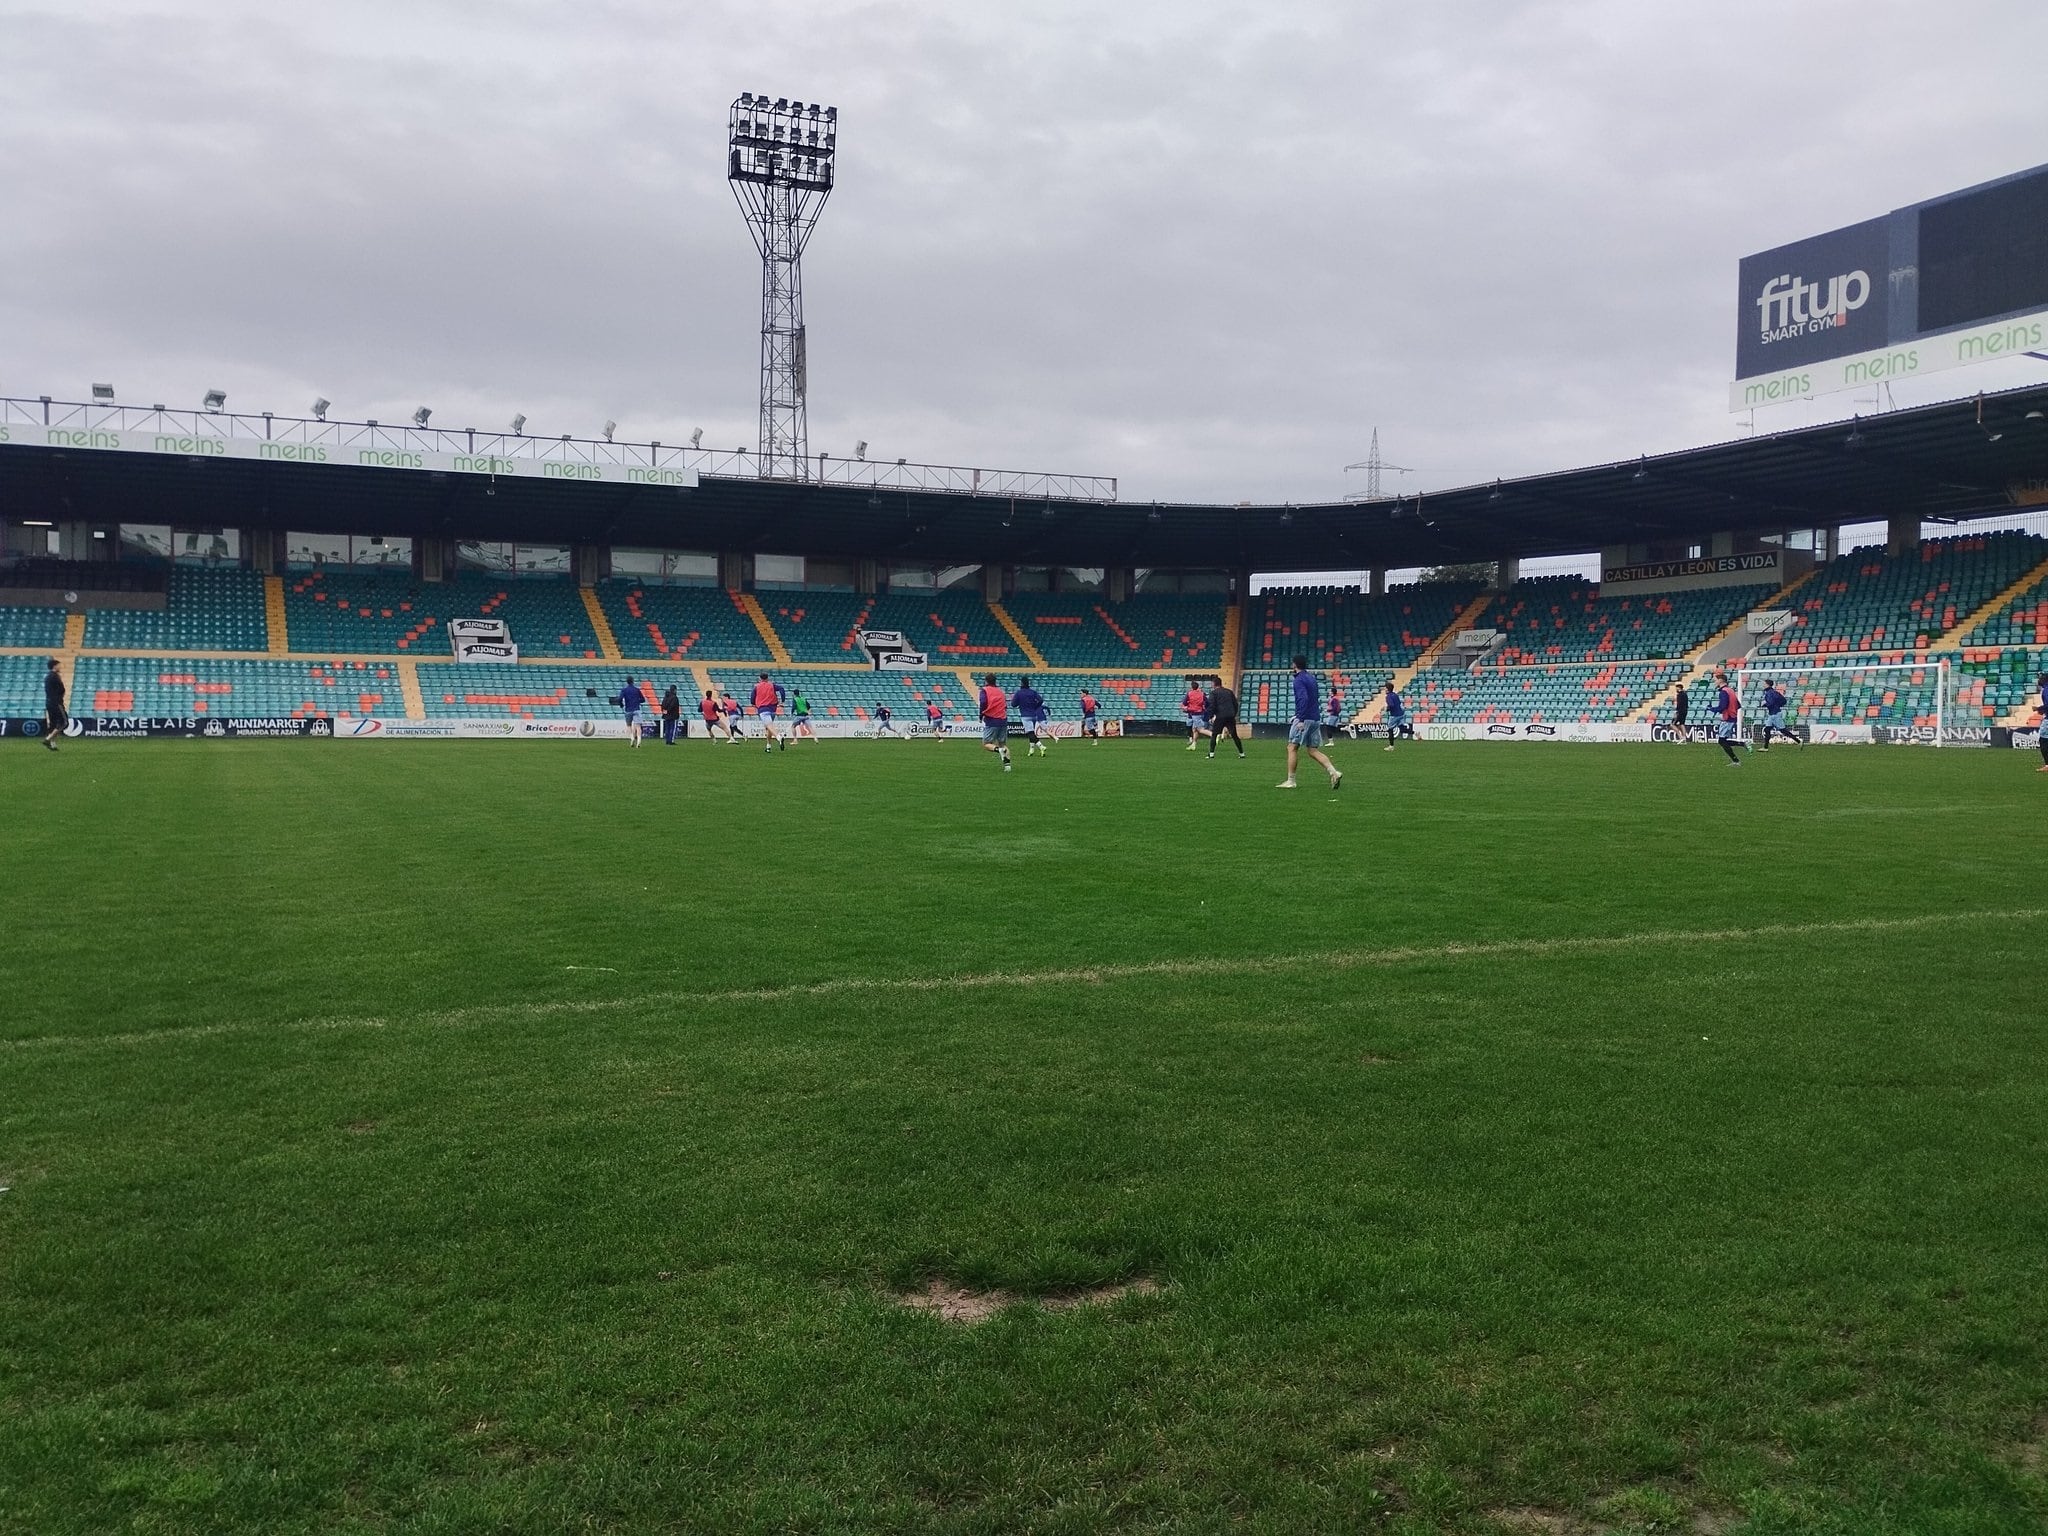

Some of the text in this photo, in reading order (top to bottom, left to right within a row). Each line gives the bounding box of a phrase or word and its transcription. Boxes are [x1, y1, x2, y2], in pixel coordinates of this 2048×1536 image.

[1757, 269, 1871, 332] fitup
[1761, 316, 1837, 345] SMART GYM
[1958, 322, 2042, 361] meins
[1845, 350, 1919, 384] meins
[1745, 373, 1811, 405] meins
[48, 429, 120, 448] meins
[155, 435, 225, 456] meins
[259, 442, 327, 462] meins
[359, 450, 423, 468] meins
[454, 455, 514, 474] meins
[543, 460, 601, 480] meins
[627, 467, 683, 485] meins
[1605, 565, 1665, 582] CASTILLA
[1668, 565, 1676, 576] Y
[1718, 558, 1737, 571] ES
[1741, 555, 1776, 569] VIDA
[471, 646, 506, 656] ALJOMAR
[228, 718, 307, 729] MINIMARKET
[526, 724, 577, 732] BricoCentro
[1428, 724, 1466, 740] meins
